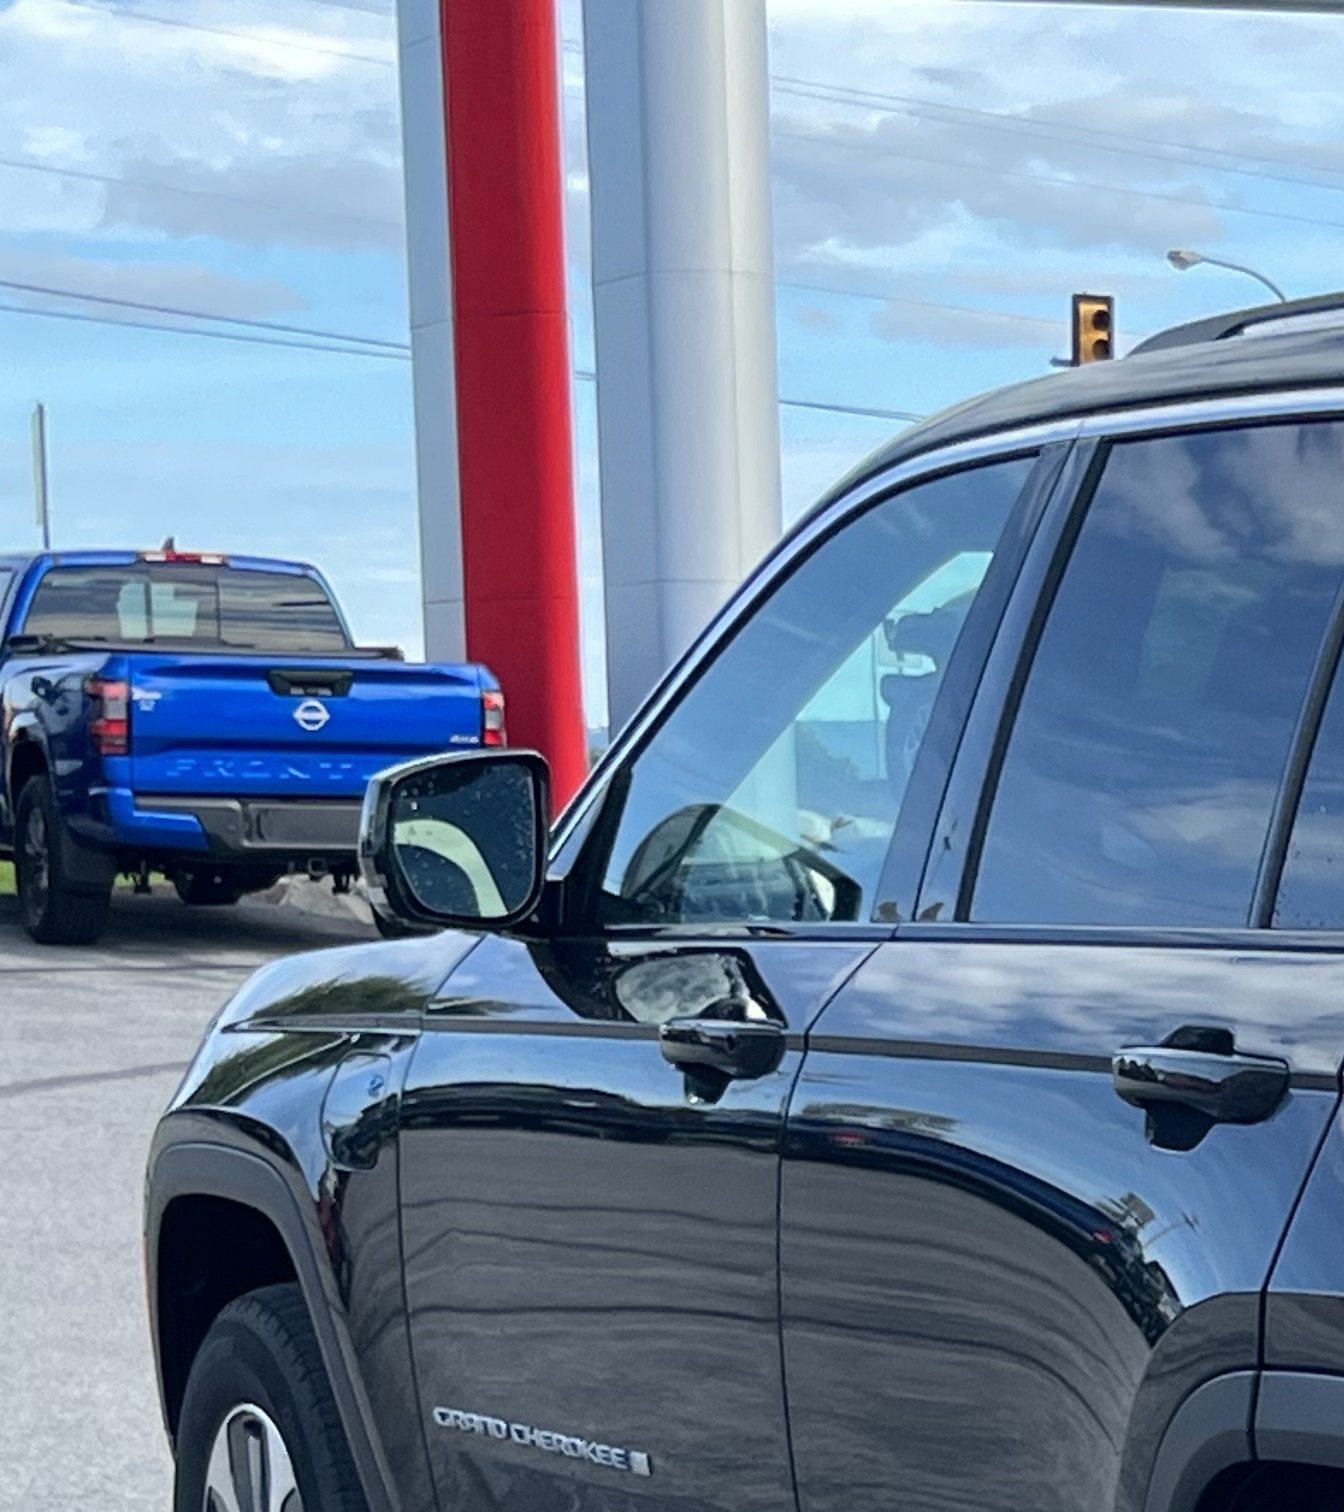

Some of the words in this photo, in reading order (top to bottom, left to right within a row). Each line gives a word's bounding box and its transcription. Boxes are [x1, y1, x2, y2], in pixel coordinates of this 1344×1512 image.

[166, 758, 371, 779] FRONT
[432, 1406, 508, 1440] GRAND
[509, 1423, 629, 1469] CHEROKEE
